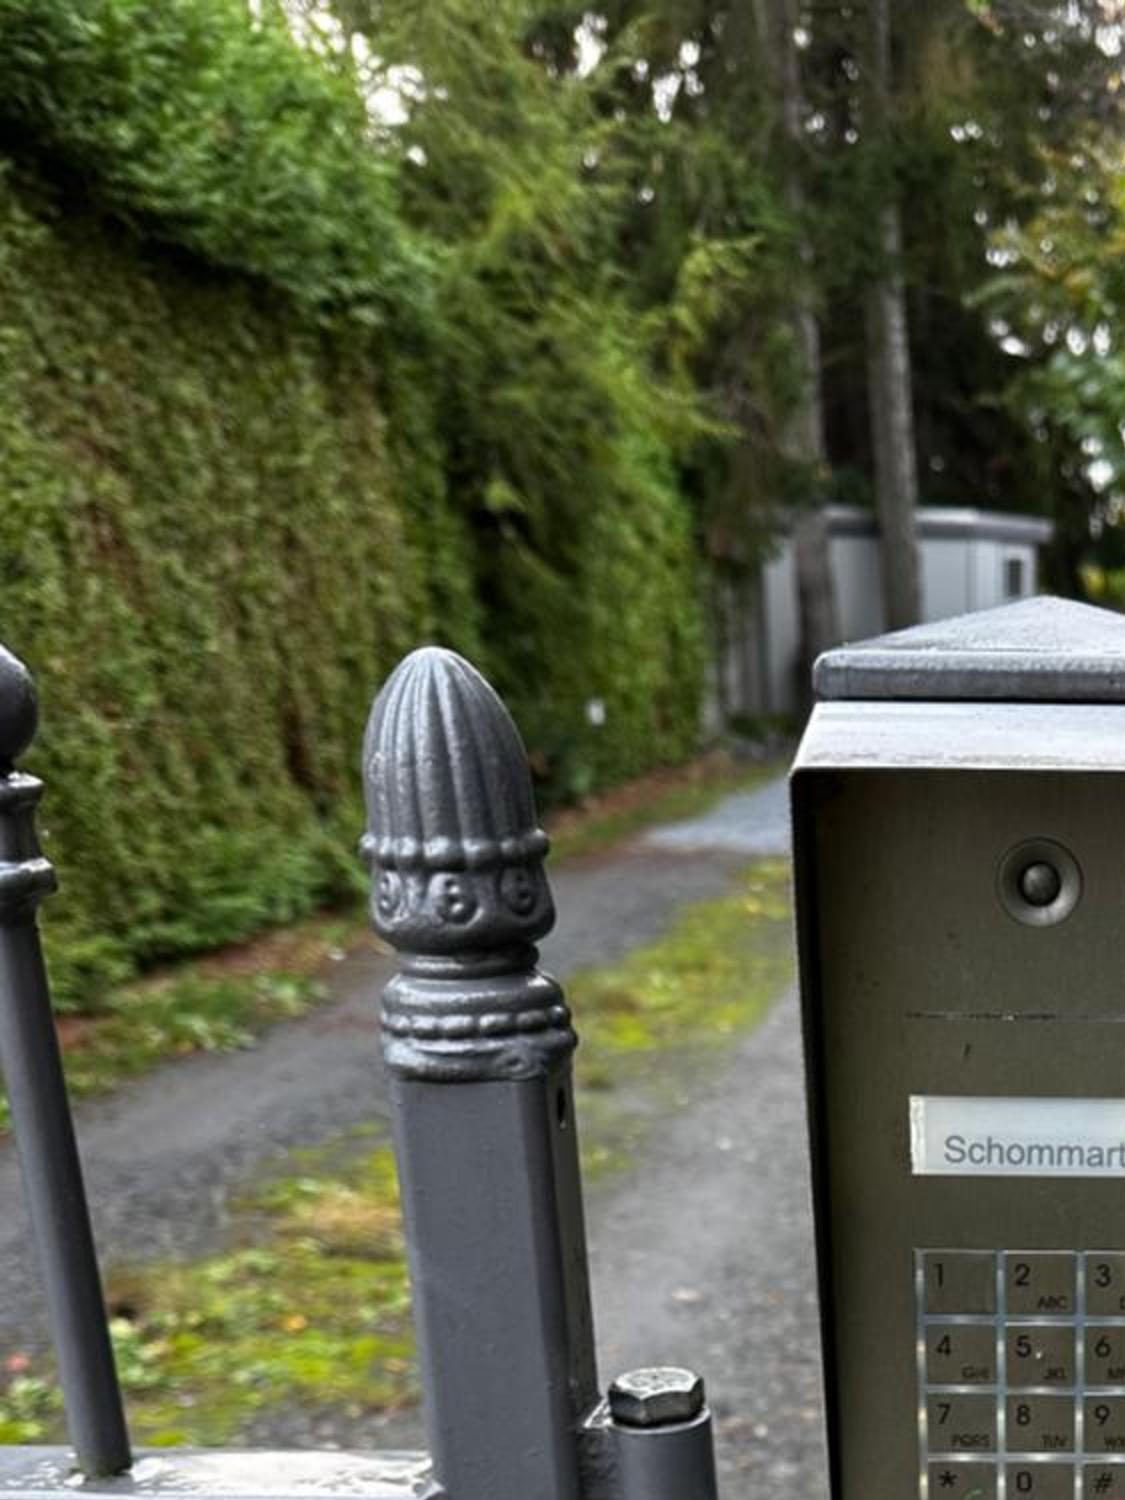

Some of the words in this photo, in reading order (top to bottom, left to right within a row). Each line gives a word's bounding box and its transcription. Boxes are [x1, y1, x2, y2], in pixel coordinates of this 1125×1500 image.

[933, 1263, 944, 1287] 1
[1014, 1263, 1031, 1287] 2
[1095, 1263, 1111, 1288] 3
[1037, 1295, 1069, 1310] ABC
[936, 1335, 952, 1356] 4
[1015, 1335, 1032, 1358] 5
[1095, 1336, 1111, 1358] 6
[937, 1403, 951, 1425] 7
[1016, 1404, 1031, 1426] 8
[1094, 1404, 1110, 1427] 9
[1016, 1471, 1033, 1492] 0
